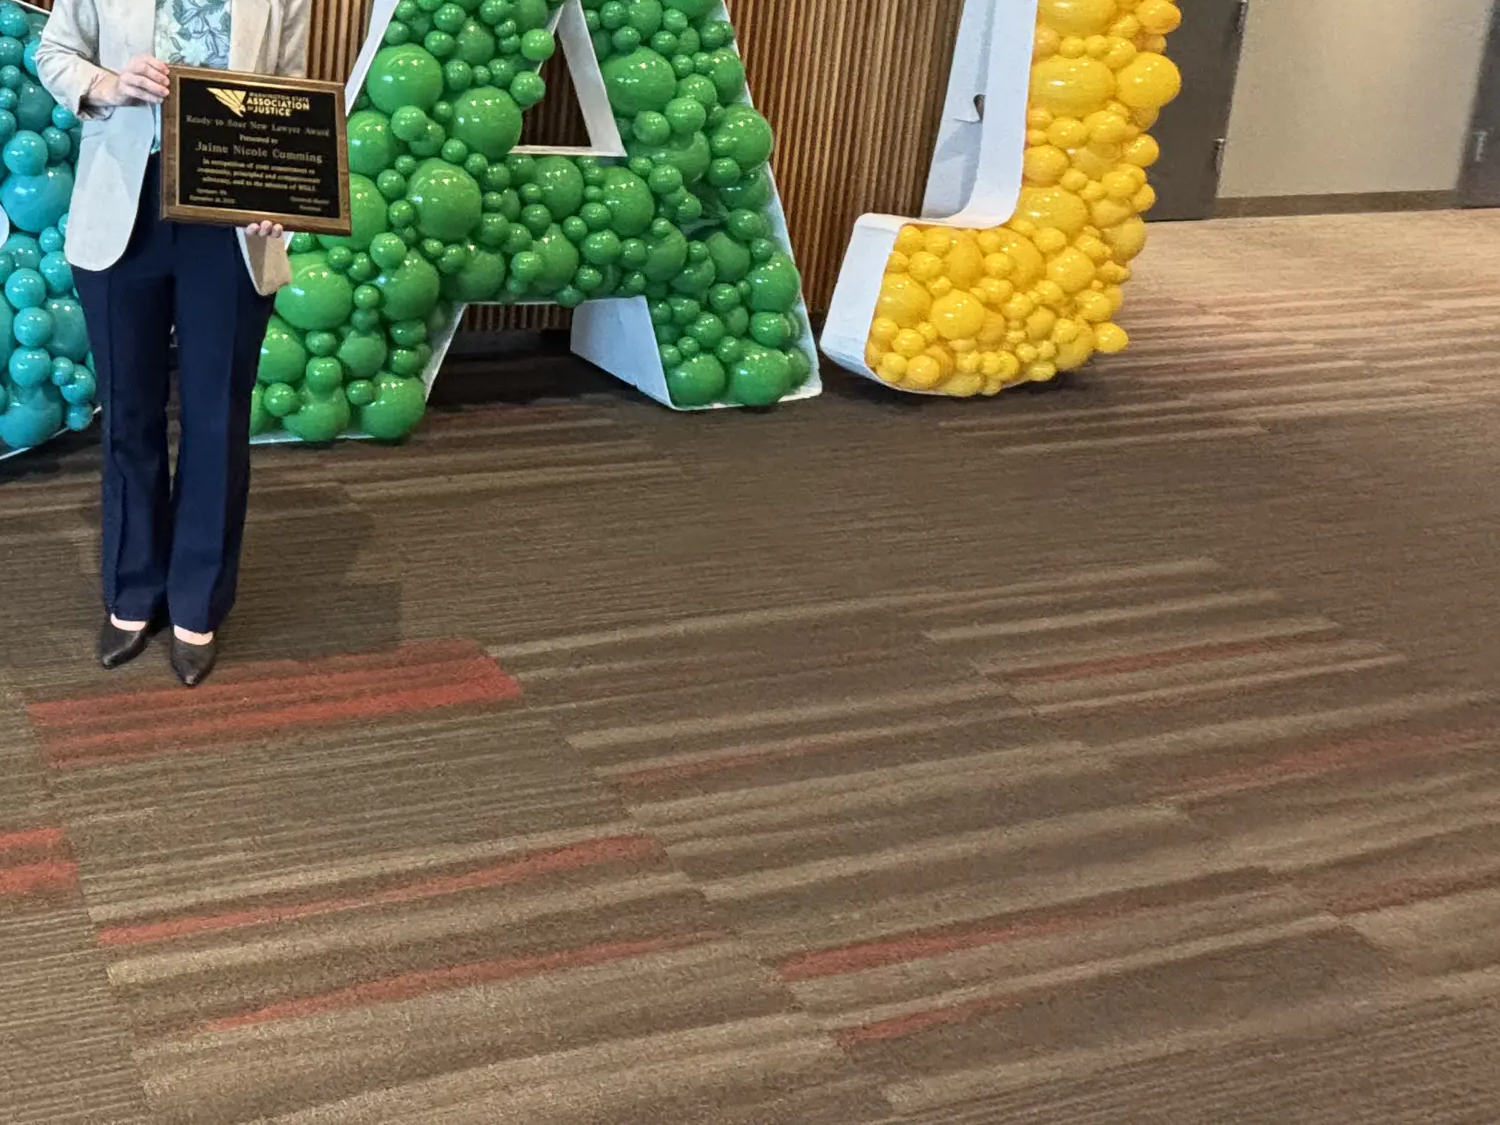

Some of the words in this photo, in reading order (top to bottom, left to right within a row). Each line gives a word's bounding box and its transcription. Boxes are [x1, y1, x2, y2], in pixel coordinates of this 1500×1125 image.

[246, 97, 310, 111] ASSOCIATION
[253, 105, 291, 117] JUSTICE
[186, 115, 211, 127] Ready
[215, 118, 224, 127] to
[250, 121, 268, 131] New
[271, 123, 301, 135] Lawyer
[304, 127, 330, 139] Award
[195, 141, 229, 154] Jaime
[233, 144, 268, 157] Nicole
[272, 148, 323, 164] Cumming
